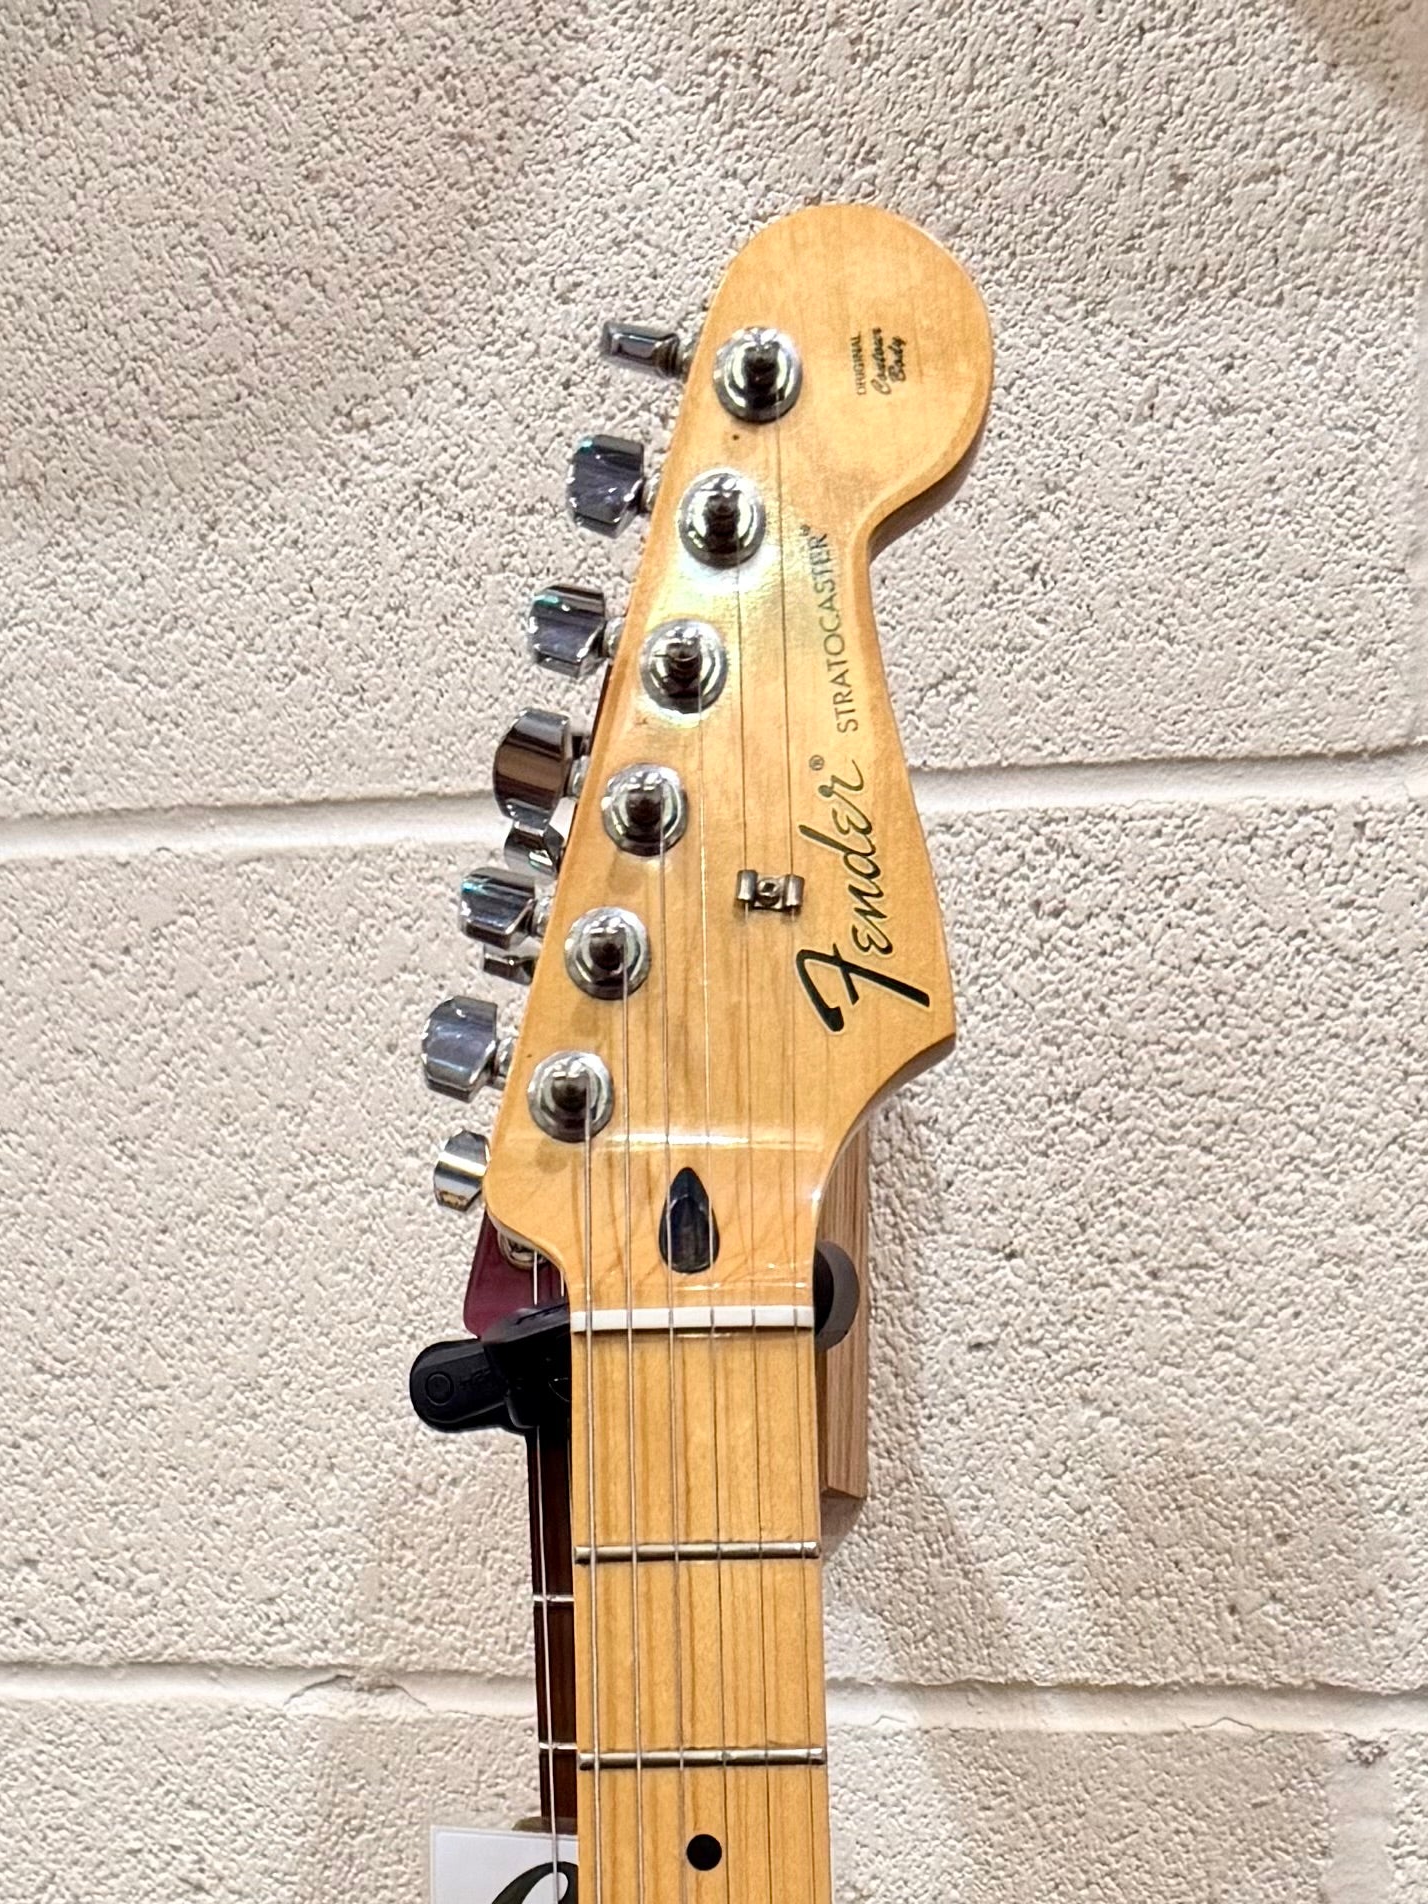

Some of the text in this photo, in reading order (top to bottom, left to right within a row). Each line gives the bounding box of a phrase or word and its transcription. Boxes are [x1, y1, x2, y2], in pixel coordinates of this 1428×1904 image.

[850, 332, 867, 396] ORIGINAL
[886, 336, 907, 384] Body
[808, 533, 860, 734] STRATOCASTER
[795, 759, 930, 1034] Fender
